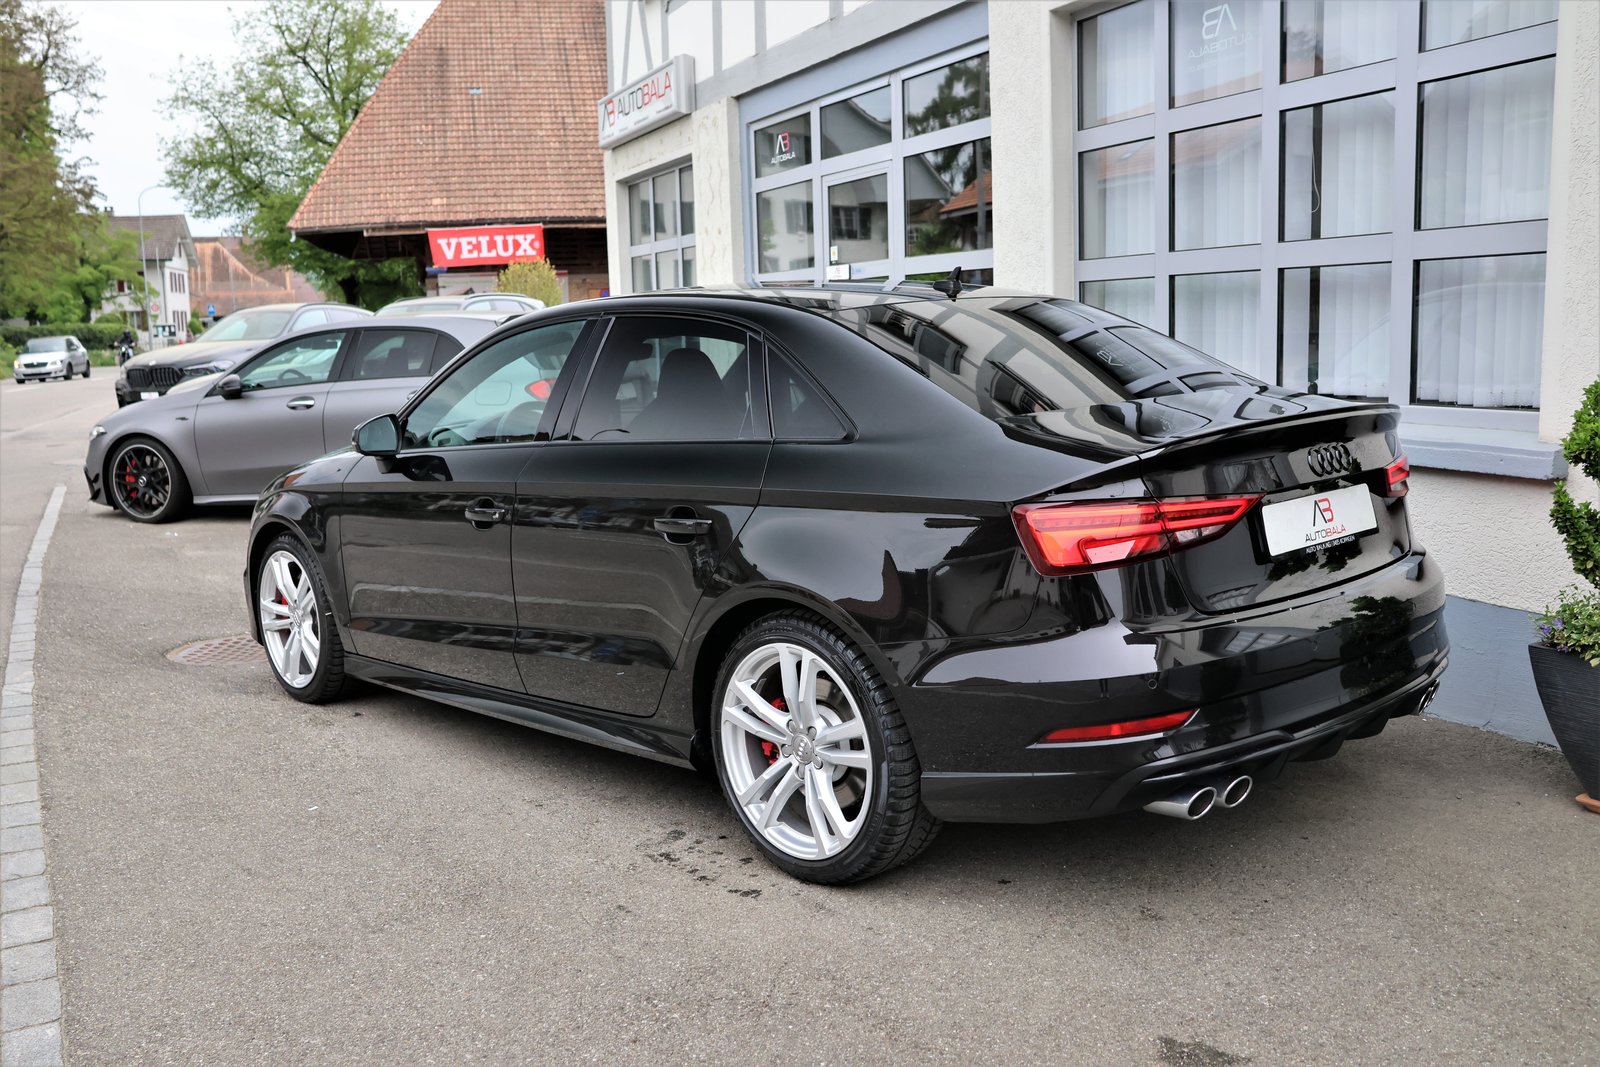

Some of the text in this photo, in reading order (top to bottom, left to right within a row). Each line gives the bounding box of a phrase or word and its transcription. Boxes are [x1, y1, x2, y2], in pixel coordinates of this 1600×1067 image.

[617, 71, 672, 119] AUTOBALA
[771, 151, 796, 164] AUTOBALA
[437, 234, 537, 260] VELUX
[1305, 524, 1346, 542] AUTOBALA
